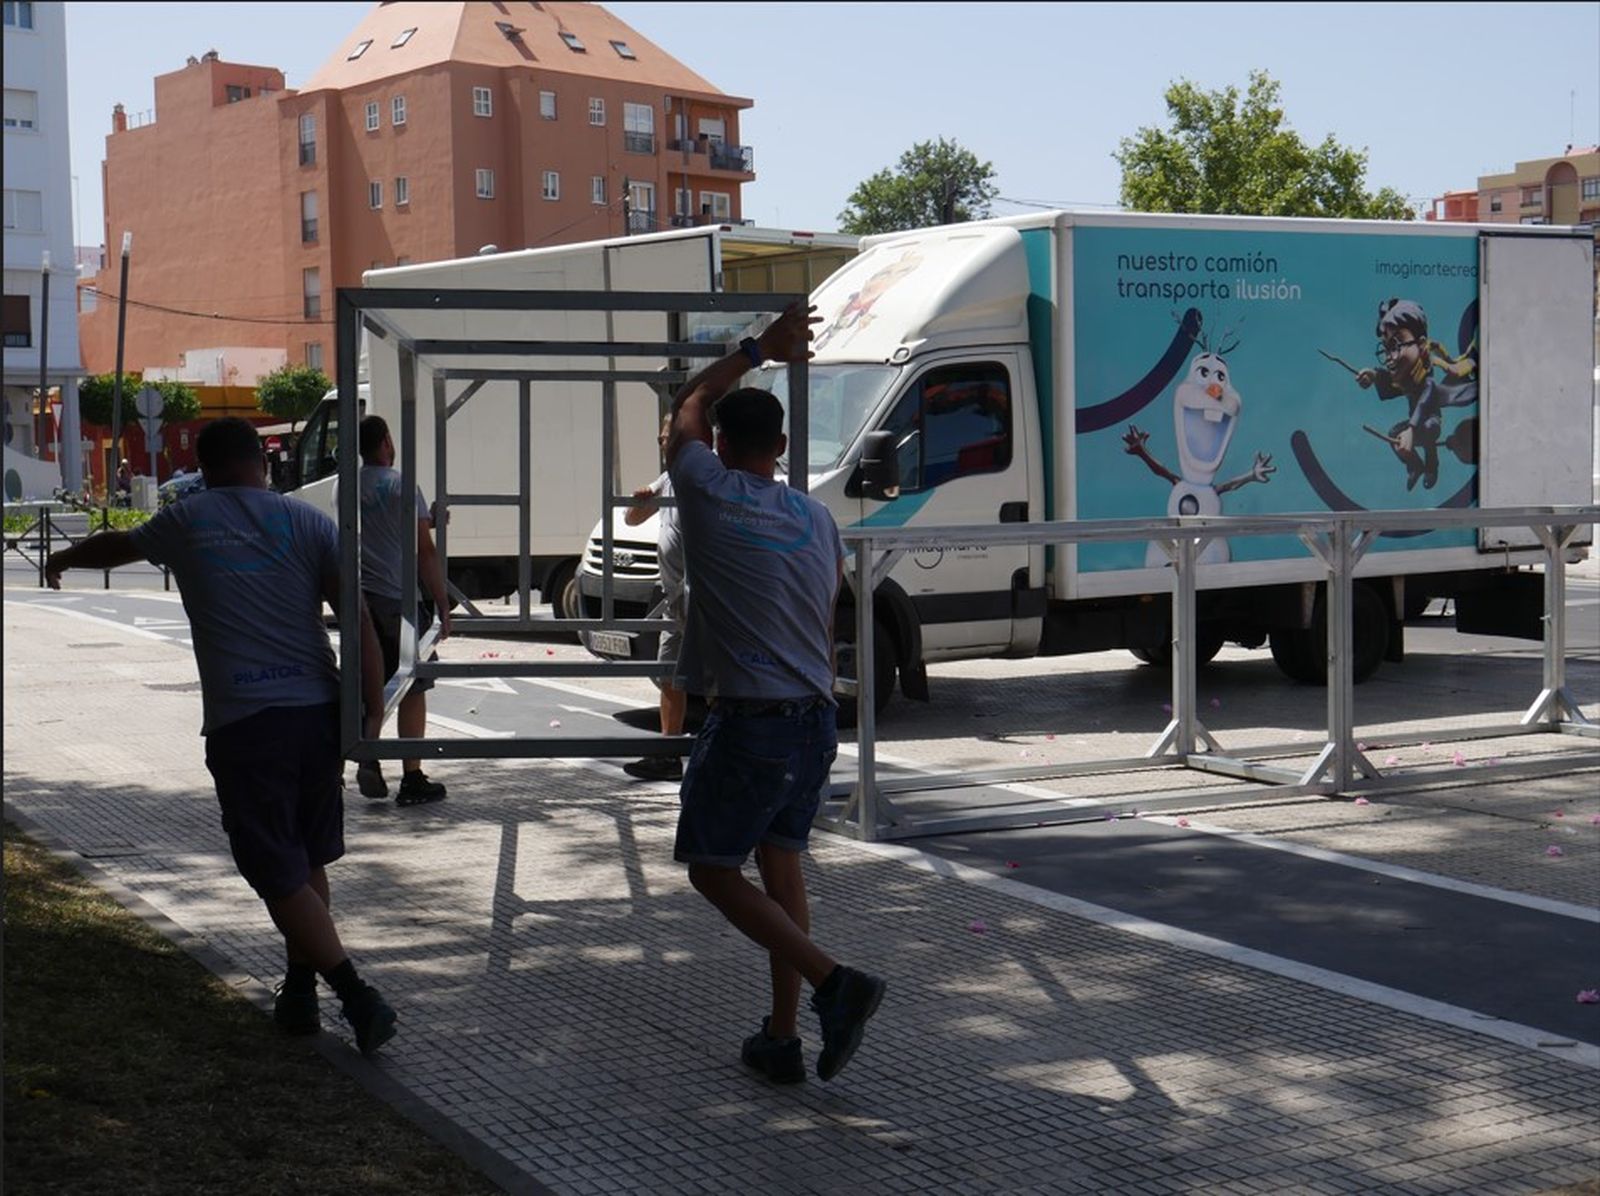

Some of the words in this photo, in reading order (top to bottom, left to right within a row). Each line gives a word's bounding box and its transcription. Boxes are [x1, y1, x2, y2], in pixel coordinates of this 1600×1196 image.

[1117, 251, 1198, 271] nuestro
[1204, 251, 1278, 273] camión
[1117, 278, 1230, 304] transporta
[1235, 278, 1302, 300] ilusión
[232, 664, 303, 685] PILATOS
